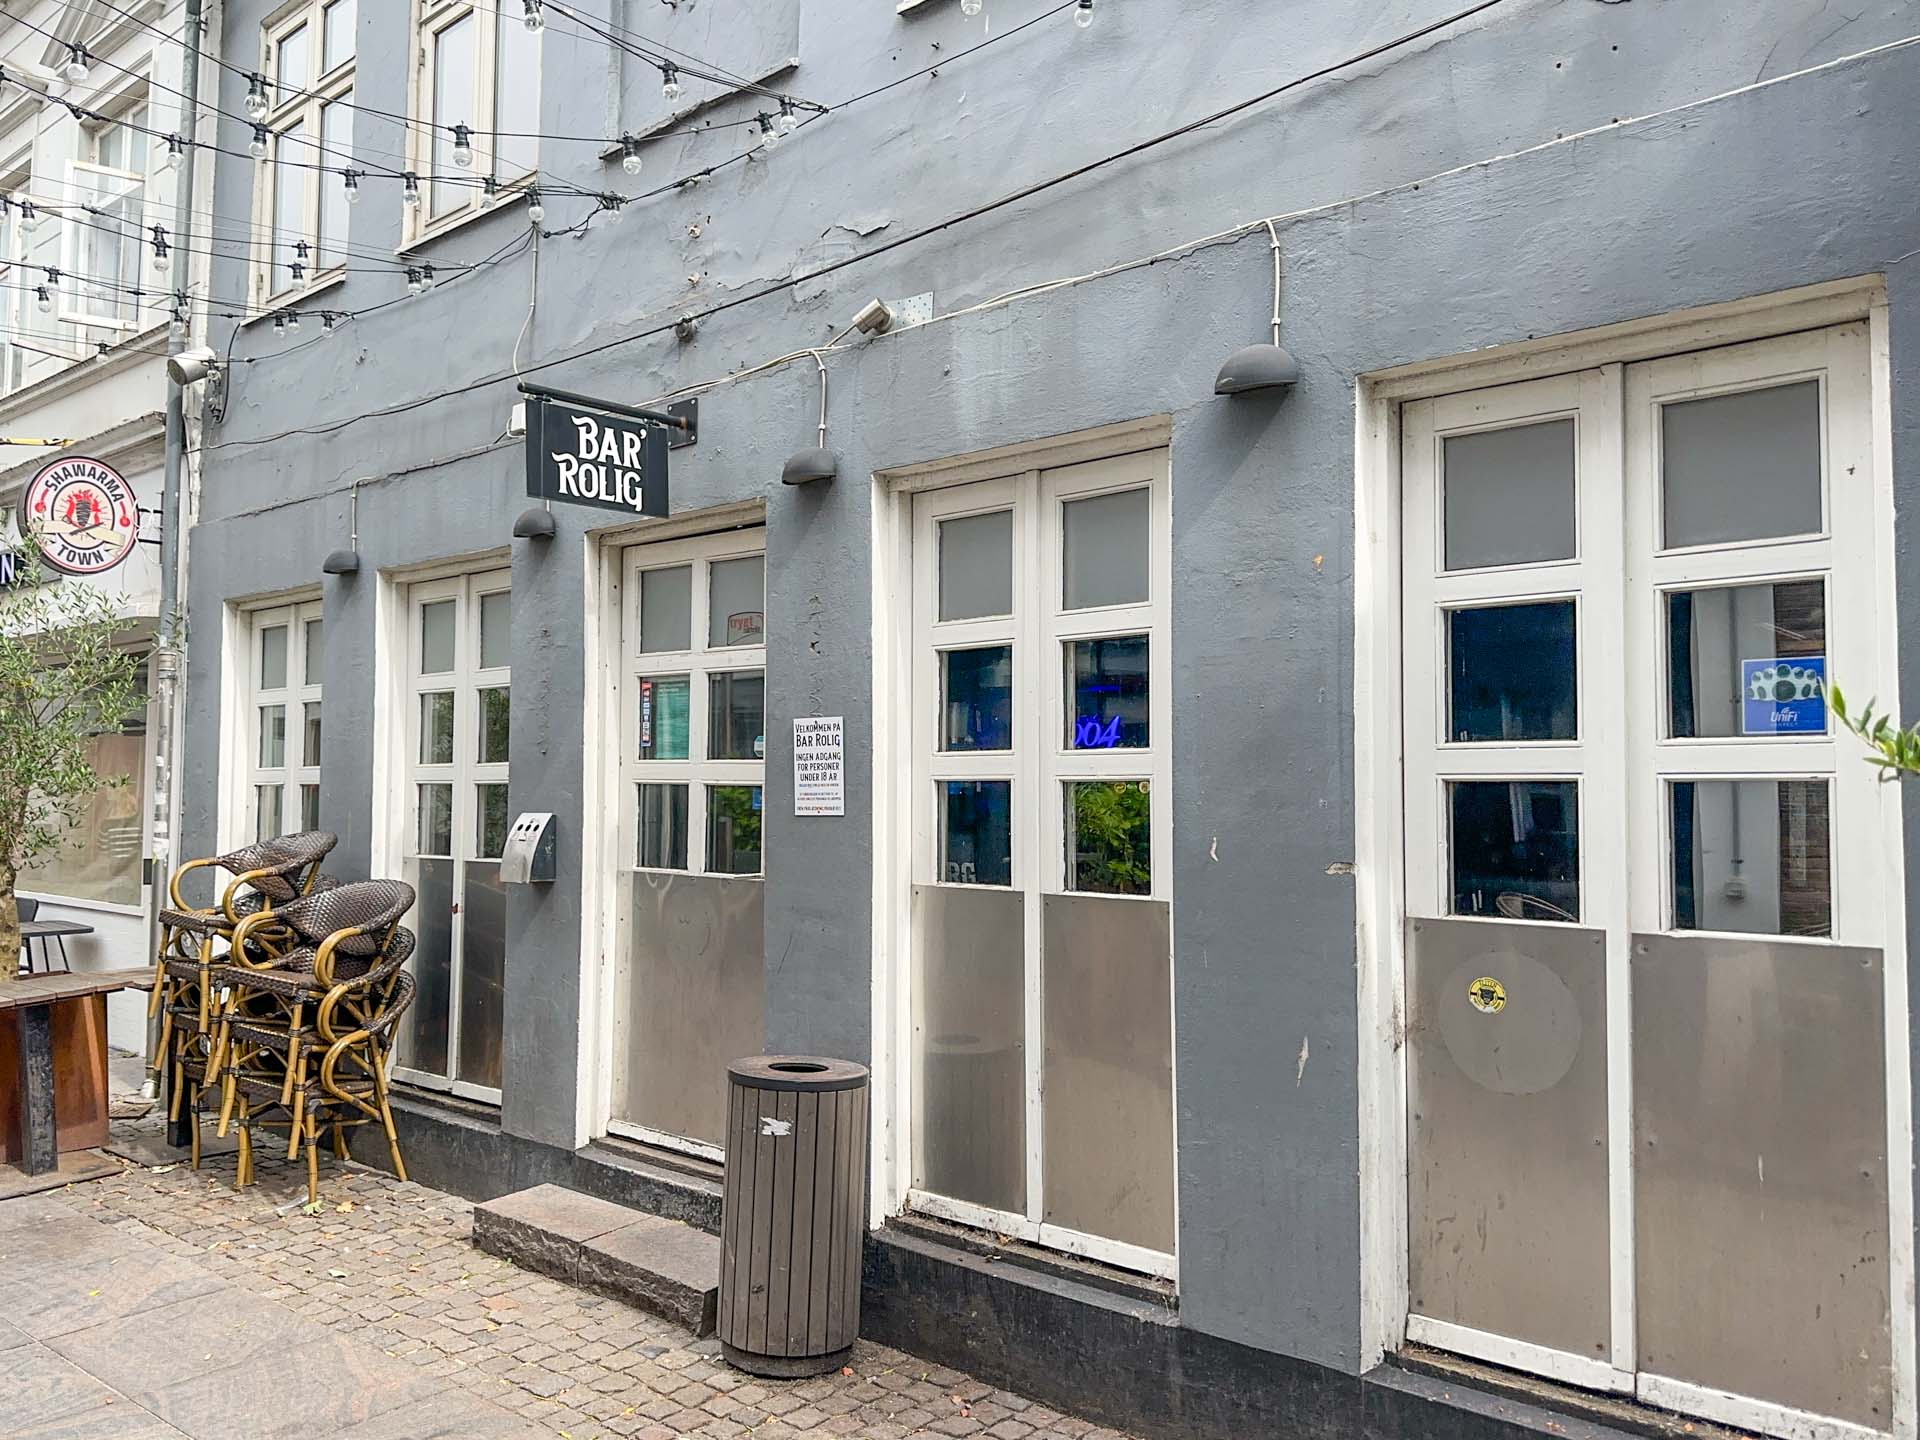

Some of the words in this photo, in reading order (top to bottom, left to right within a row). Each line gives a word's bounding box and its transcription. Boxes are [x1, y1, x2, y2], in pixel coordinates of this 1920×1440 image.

[45, 463, 125, 503] SHAWARMA
[552, 452, 643, 512] ROLIG
[57, 544, 104, 566] TOWN
[1771, 709, 1798, 721] UniFi
[796, 734, 813, 747] BAR
[816, 734, 840, 747] ROLIG
[796, 753, 814, 761] INGEN
[816, 752, 841, 760] ADGANG
[810, 762, 840, 770] PERSONER
[800, 773, 820, 781] UNDER
[820, 772, 827, 781] 18
